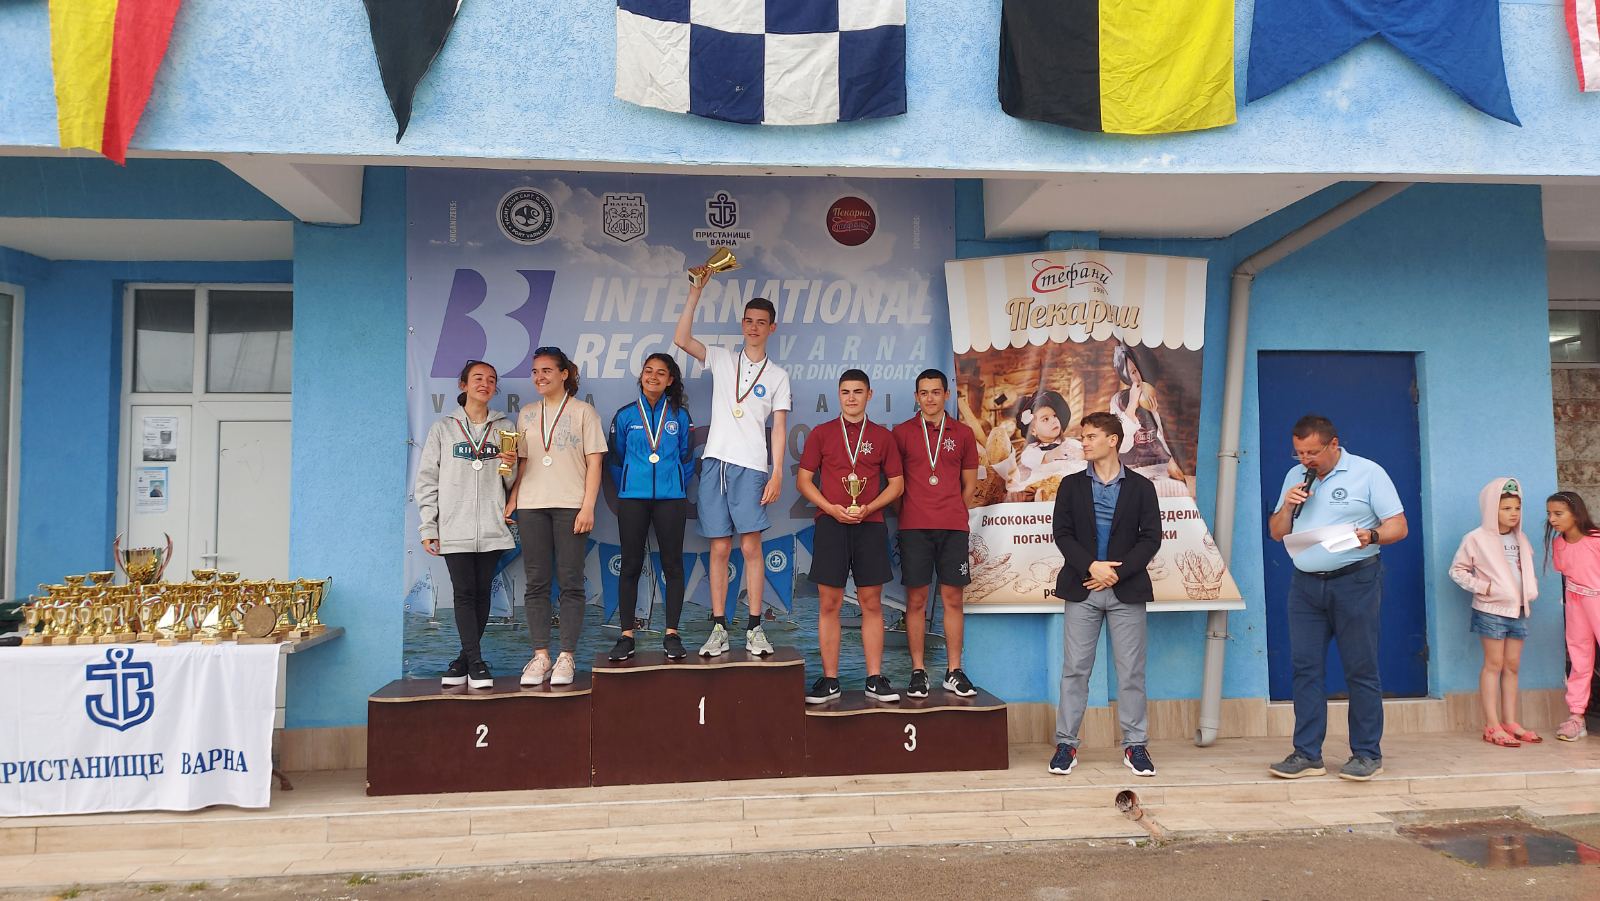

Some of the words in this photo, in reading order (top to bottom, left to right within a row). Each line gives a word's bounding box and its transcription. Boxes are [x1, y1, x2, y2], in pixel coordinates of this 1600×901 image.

[695, 231, 751, 240] ПРИСТАНИЩЕ
[1031, 262, 1112, 293] Стефани
[583, 276, 932, 325] INTERNATIONAL
[1005, 297, 1140, 334] Пекарни
[573, 333, 746, 380] REGATT
[779, 335, 926, 361] VARNA
[779, 363, 804, 380] OR
[981, 514, 1052, 527] Висококаче
[1160, 509, 1204, 522] здели
[1161, 530, 1177, 540] ки
[1043, 588, 1057, 599] ре
[697, 696, 706, 725] 1
[476, 724, 489, 748] 2
[903, 723, 917, 752] 3
[0, 752, 164, 784] РИСТАНИЩЕ
[181, 748, 249, 775] ВАРНА
